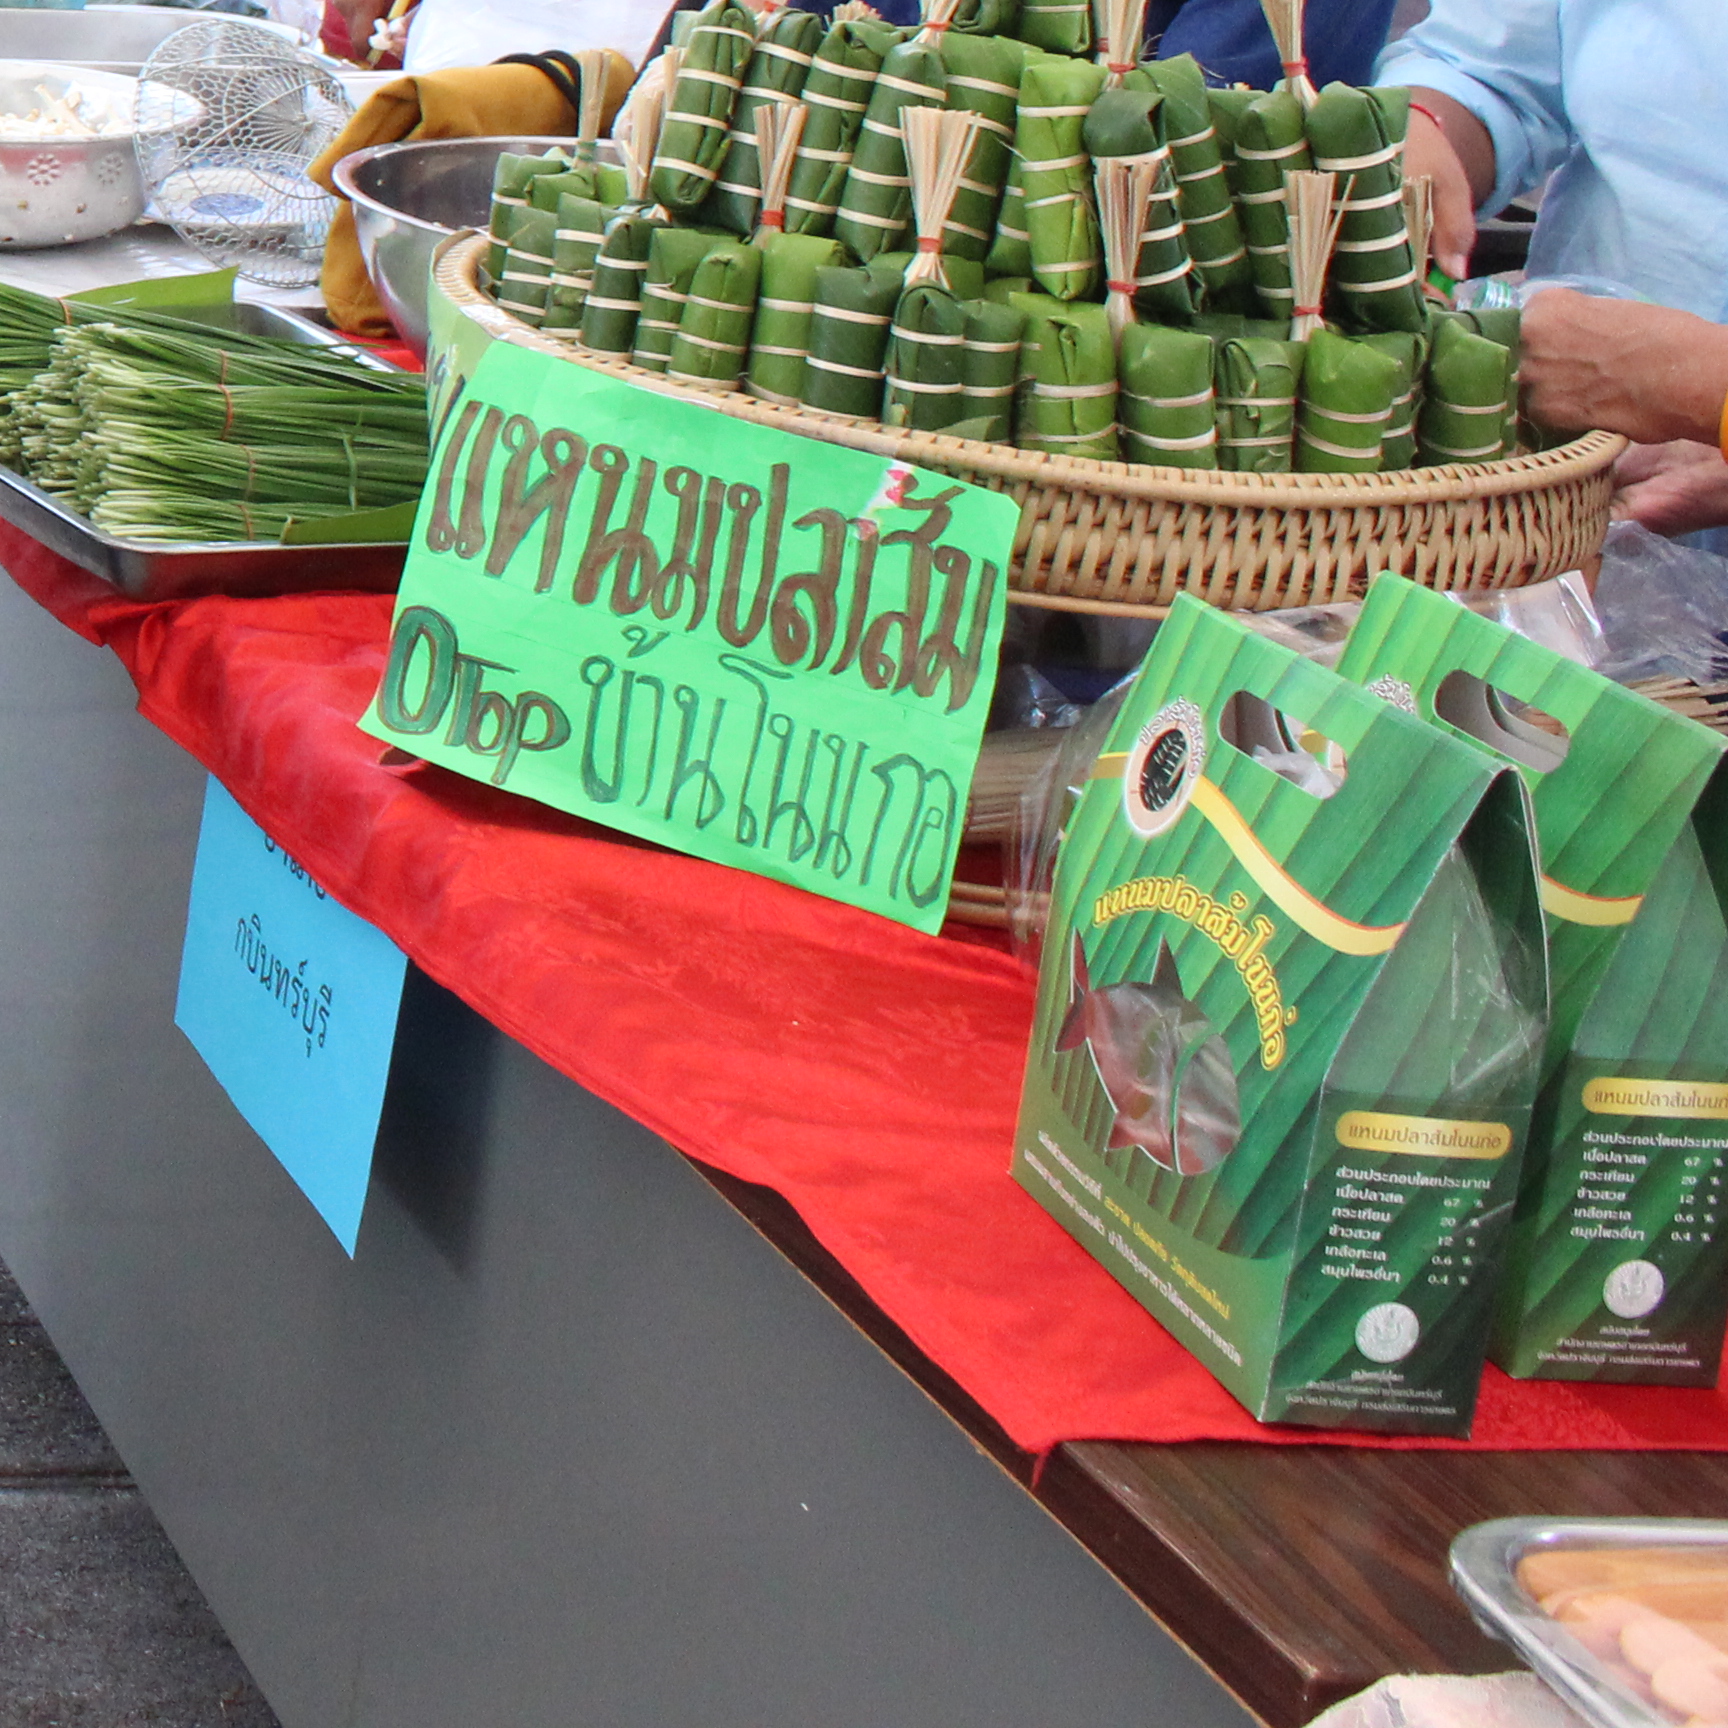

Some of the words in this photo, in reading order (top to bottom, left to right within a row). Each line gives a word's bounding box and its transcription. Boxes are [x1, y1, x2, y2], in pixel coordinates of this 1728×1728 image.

[426, 400, 999, 715] แหนมปลาส้ม
[235, 913, 333, 1058] กบินทร์บุรี
[1092, 874, 1299, 1072] แหนมปลาส้มโนนก่อ
[1348, 1123, 1502, 1149] แหนมปลาส้มโนนก่อ
[1328, 1223, 1382, 1241] ข้าวสวย
[1577, 1186, 1626, 1202] ข้าวสวย
